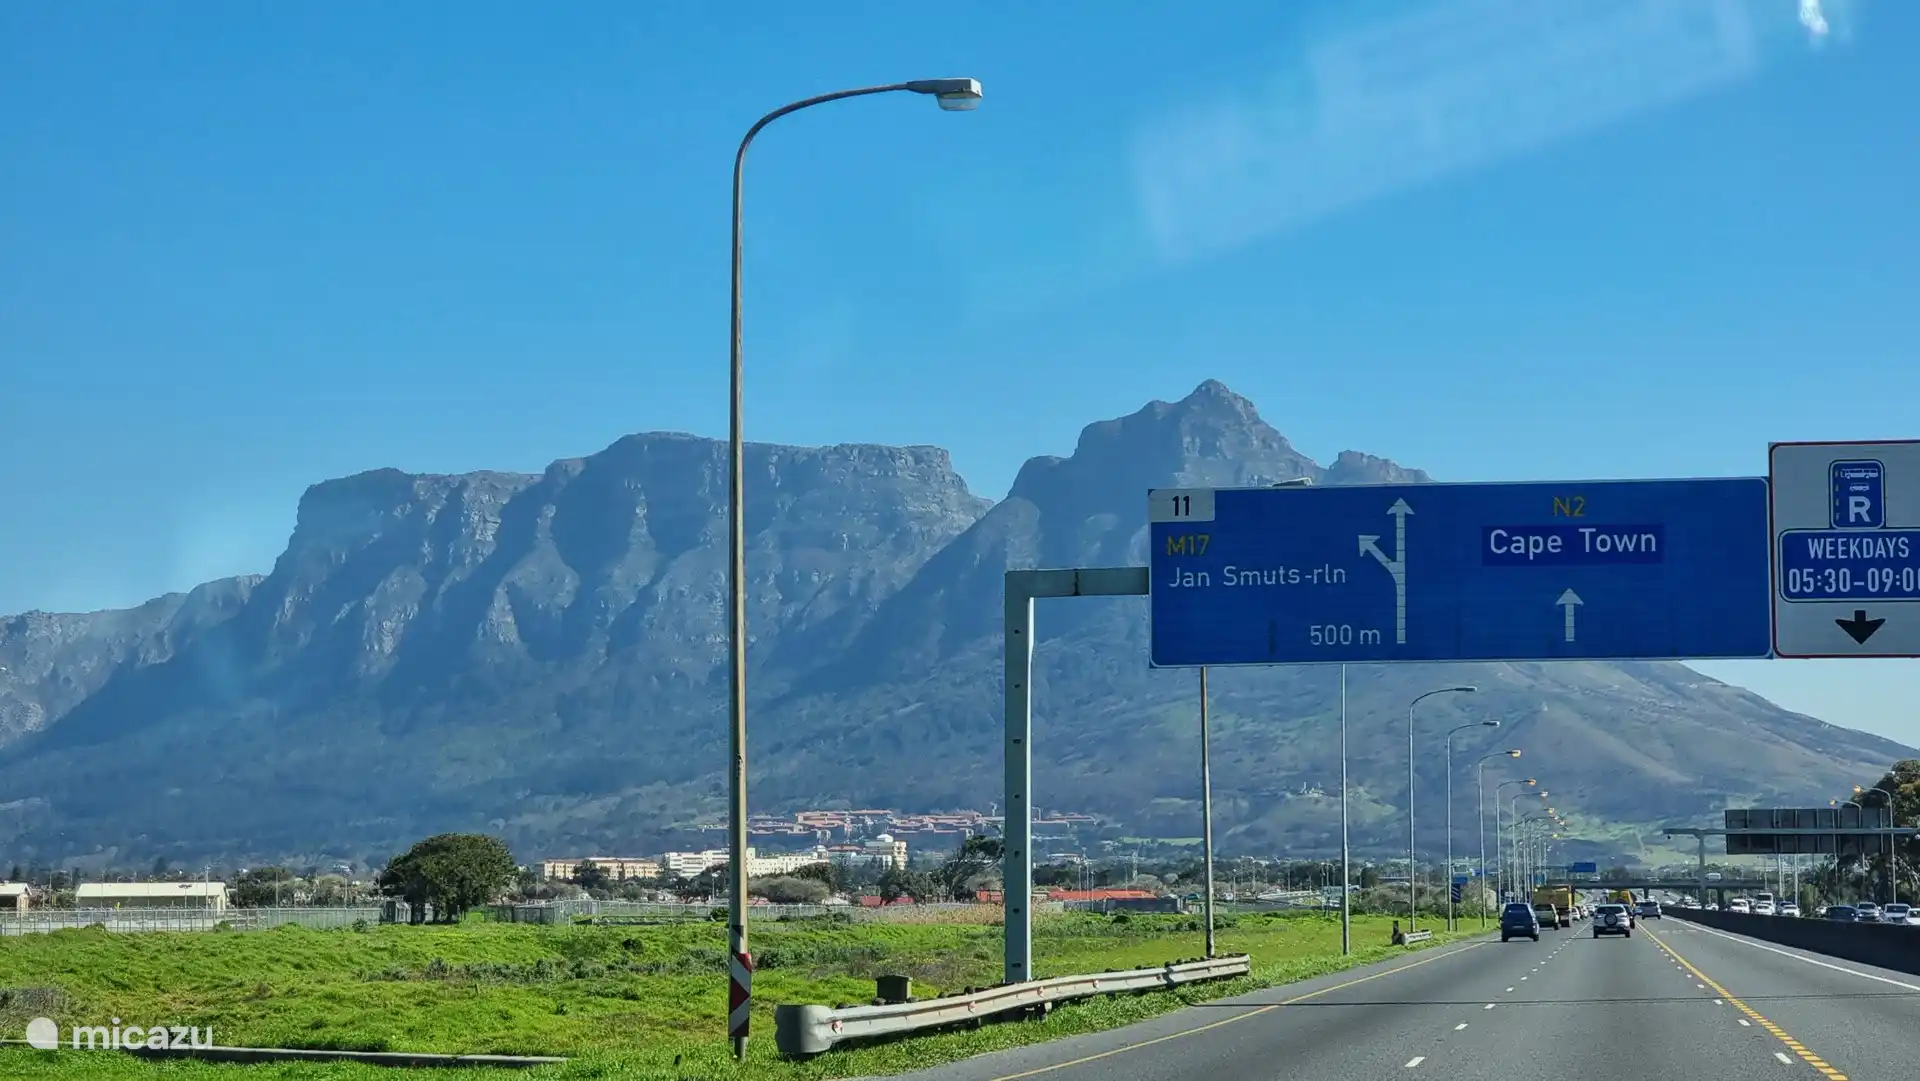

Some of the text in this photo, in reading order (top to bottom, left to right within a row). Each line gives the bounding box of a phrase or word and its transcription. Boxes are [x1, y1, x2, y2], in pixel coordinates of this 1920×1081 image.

[1172, 496, 1190, 516] 11
[1553, 496, 1586, 517] N2
[1849, 496, 1871, 522] R
[1167, 535, 1210, 556] M17
[1490, 528, 1657, 560] Cape Town
[1808, 537, 1910, 559] WEEKDAYS
[1169, 564, 1347, 587] Jan Smuts-rln
[1788, 567, 1920, 593] 05:30-09:0
[1310, 625, 1381, 645] 500 m
